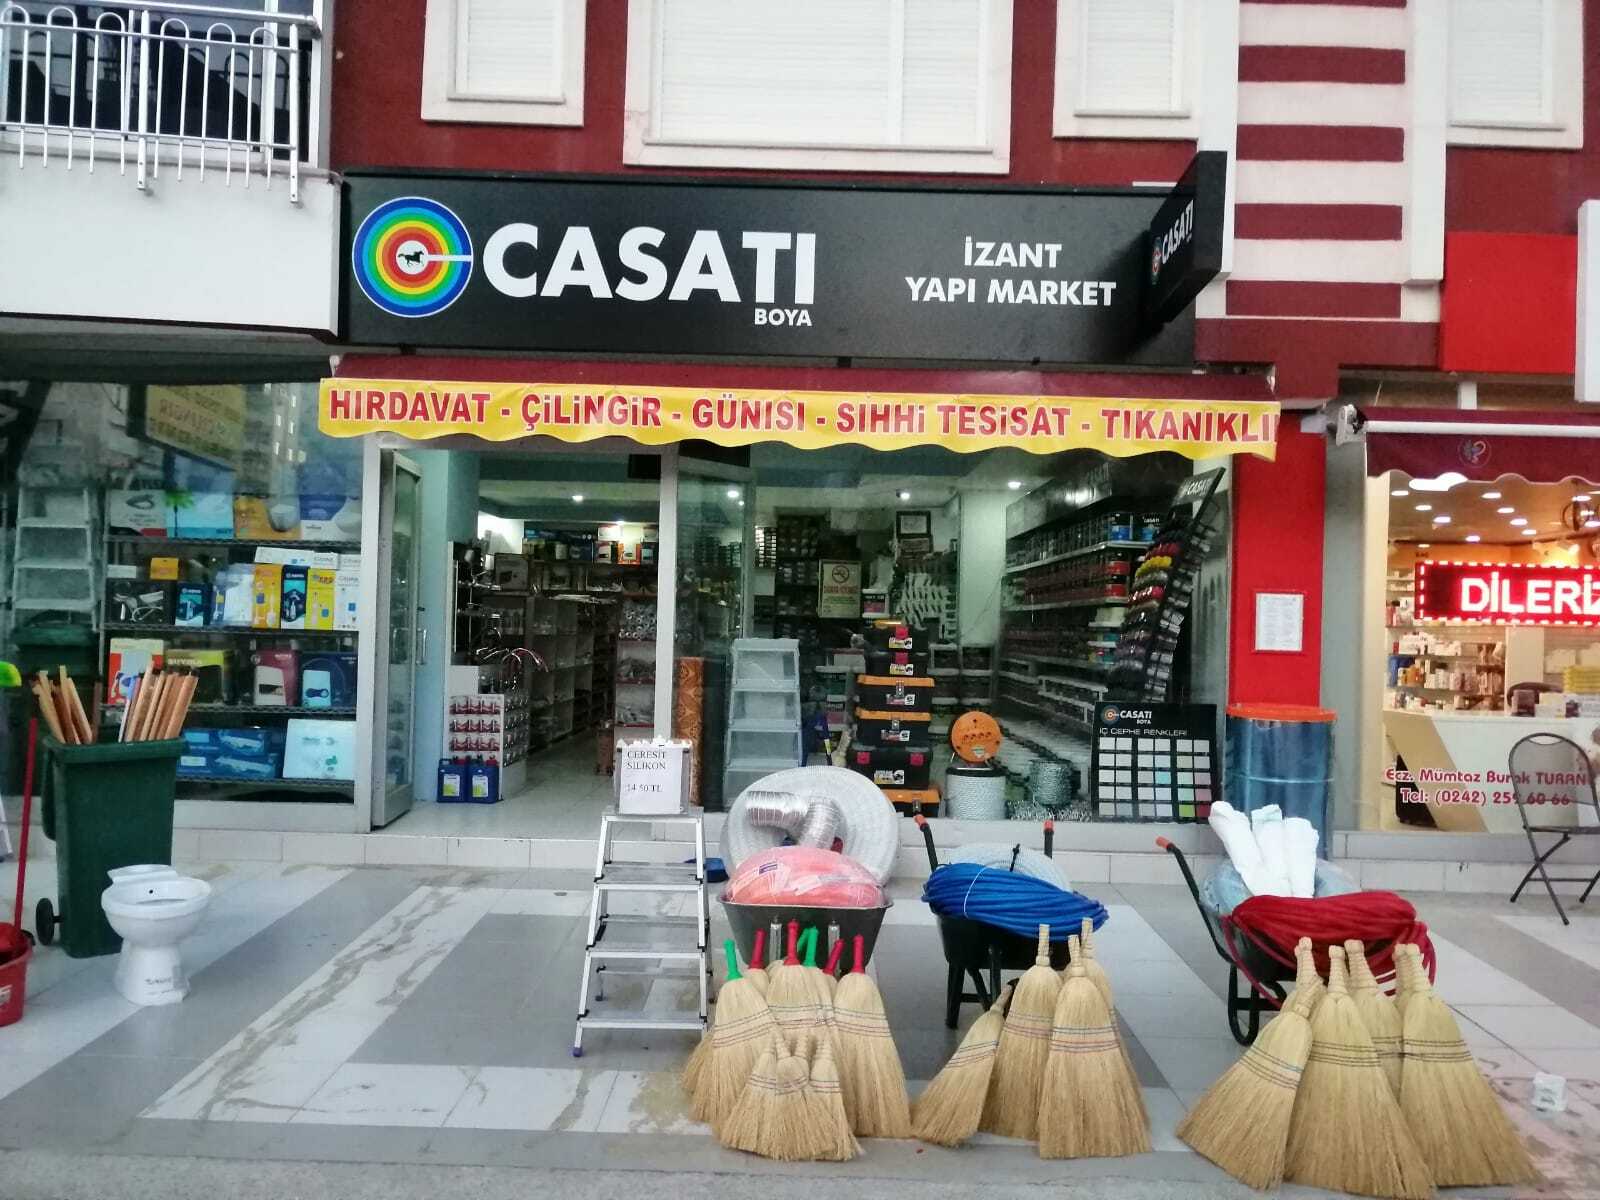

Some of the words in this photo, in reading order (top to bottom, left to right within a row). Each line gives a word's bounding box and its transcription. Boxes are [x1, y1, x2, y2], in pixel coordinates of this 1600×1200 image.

[1162, 199, 1194, 265] CASATI
[483, 222, 817, 306] CASATI
[964, 236, 1062, 268] İZANT
[905, 276, 975, 303] YAPI
[987, 279, 1117, 307] MARKET
[754, 307, 814, 328] BOYA
[330, 389, 491, 423] HIRDAVAT
[692, 393, 805, 432] GÜNISI
[1119, 710, 1153, 719] CASATI
[1419, 768, 1481, 783] Mümtaz
[1401, 788, 1429, 803] Tel:
[1435, 789, 1488, 807] (0242)
